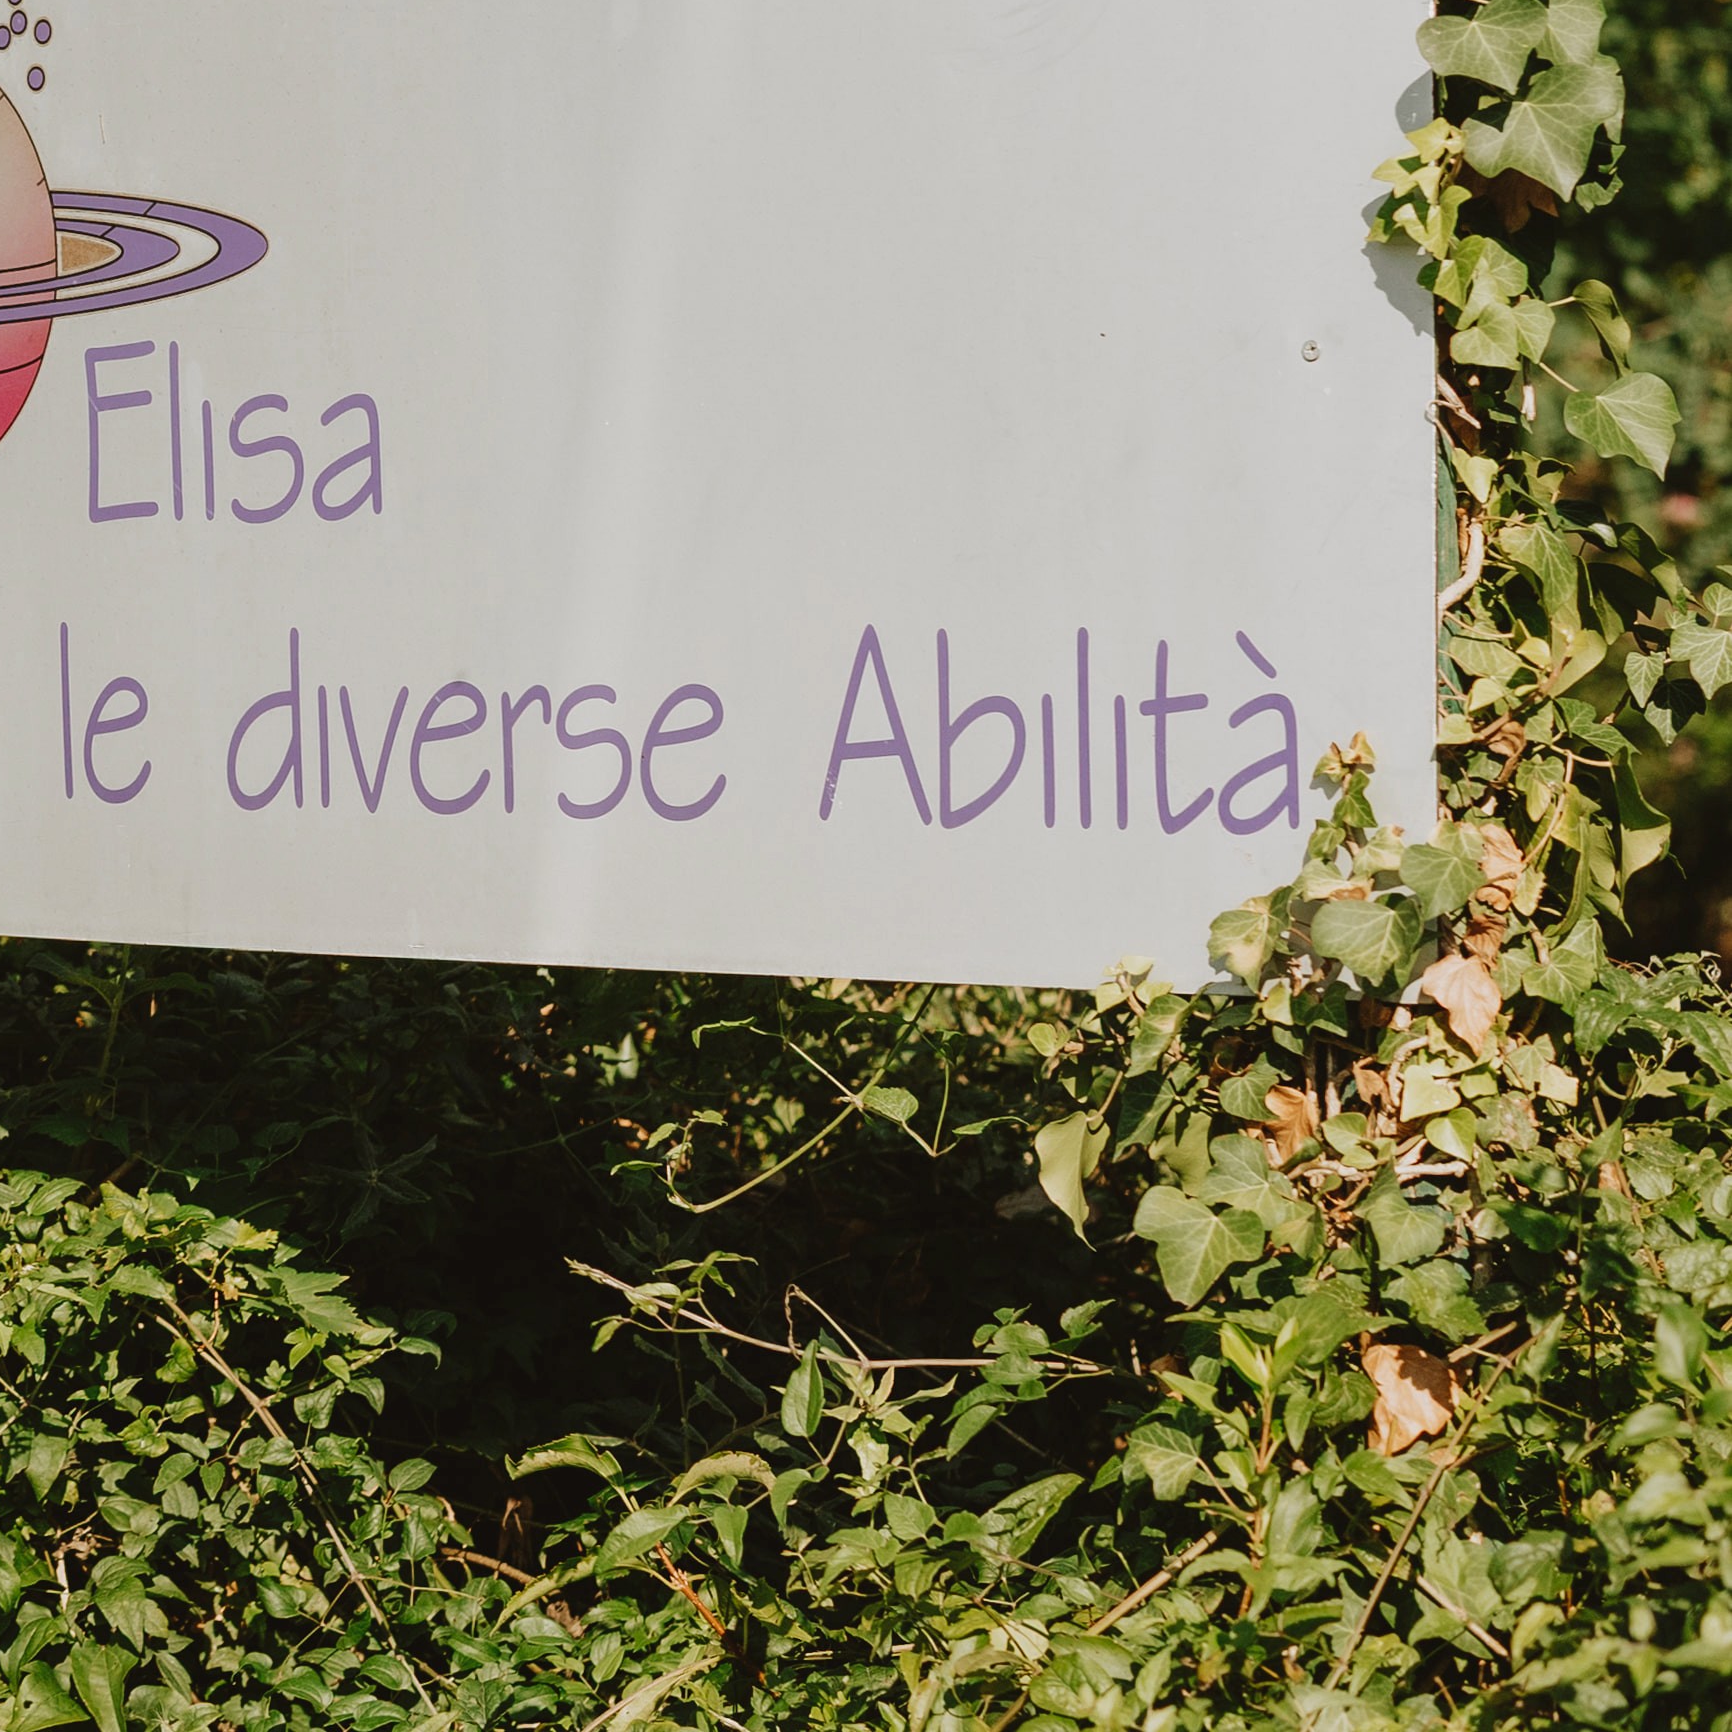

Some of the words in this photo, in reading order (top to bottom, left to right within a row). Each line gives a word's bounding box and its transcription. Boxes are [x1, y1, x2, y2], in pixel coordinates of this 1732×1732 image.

[85, 340, 383, 525] Elisa
[59, 622, 152, 804] le
[226, 627, 727, 822] diverse
[819, 623, 1302, 837] Abilità
